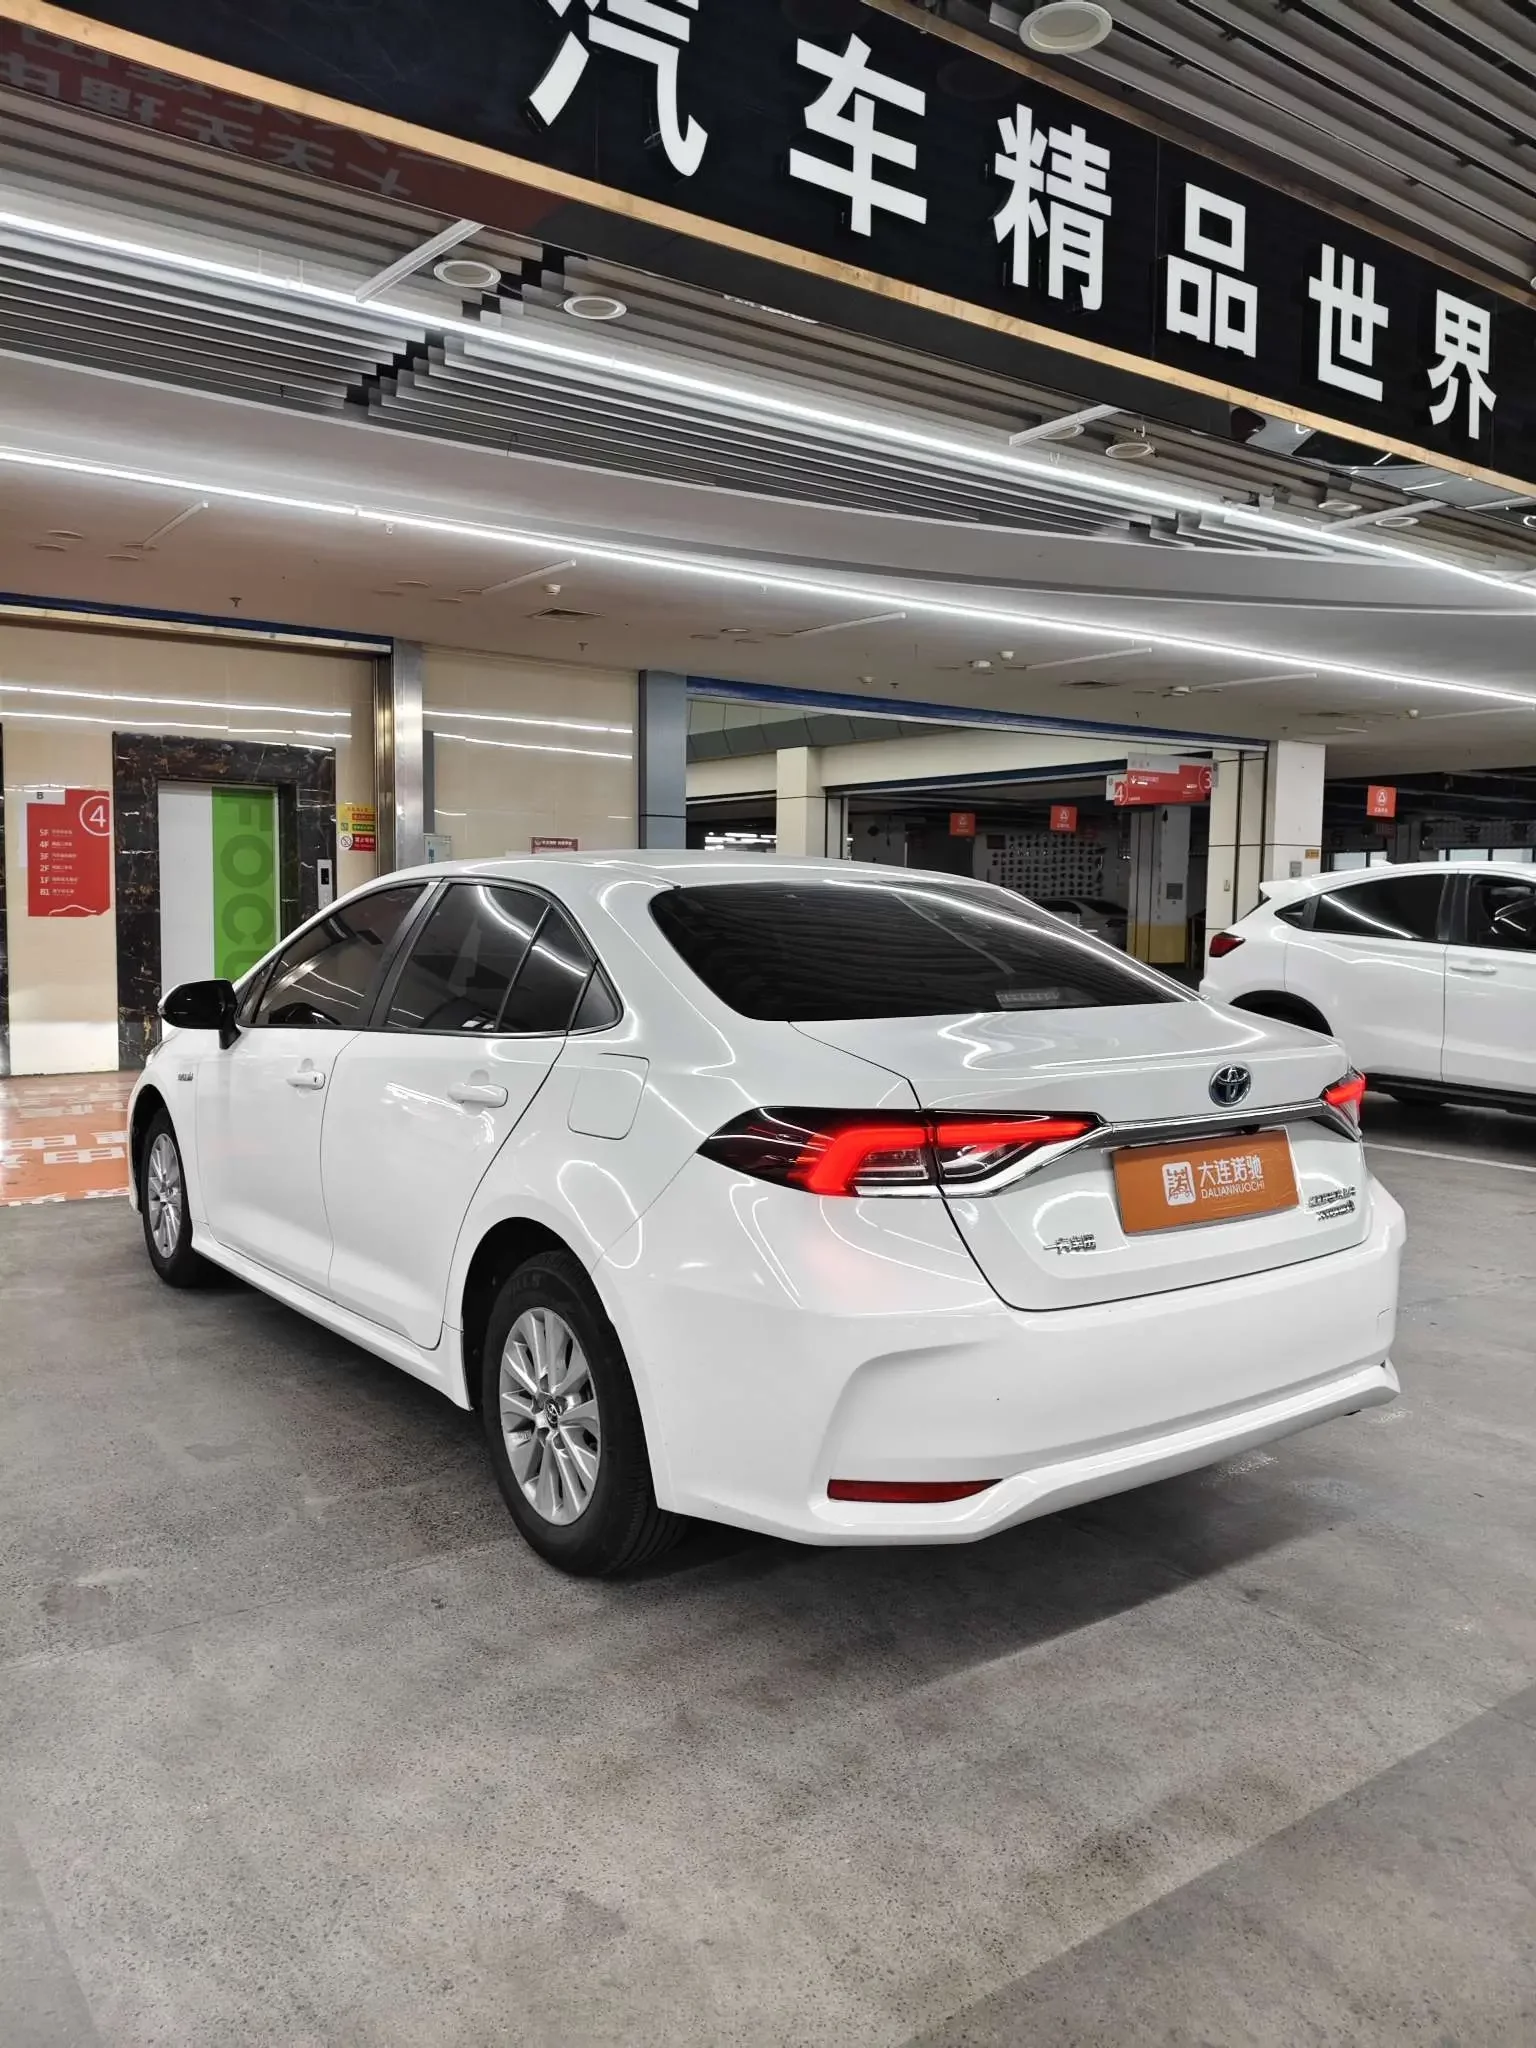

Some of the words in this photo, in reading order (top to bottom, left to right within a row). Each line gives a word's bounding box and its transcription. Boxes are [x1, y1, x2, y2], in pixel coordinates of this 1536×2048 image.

[529, 0, 1496, 440] 汽车精品世界
[1113, 783, 1124, 802] 4
[89, 805, 107, 828] 4
[1197, 1154, 1264, 1188] 大连诺驰
[1201, 1180, 1265, 1199] DALIANNUOCHI
